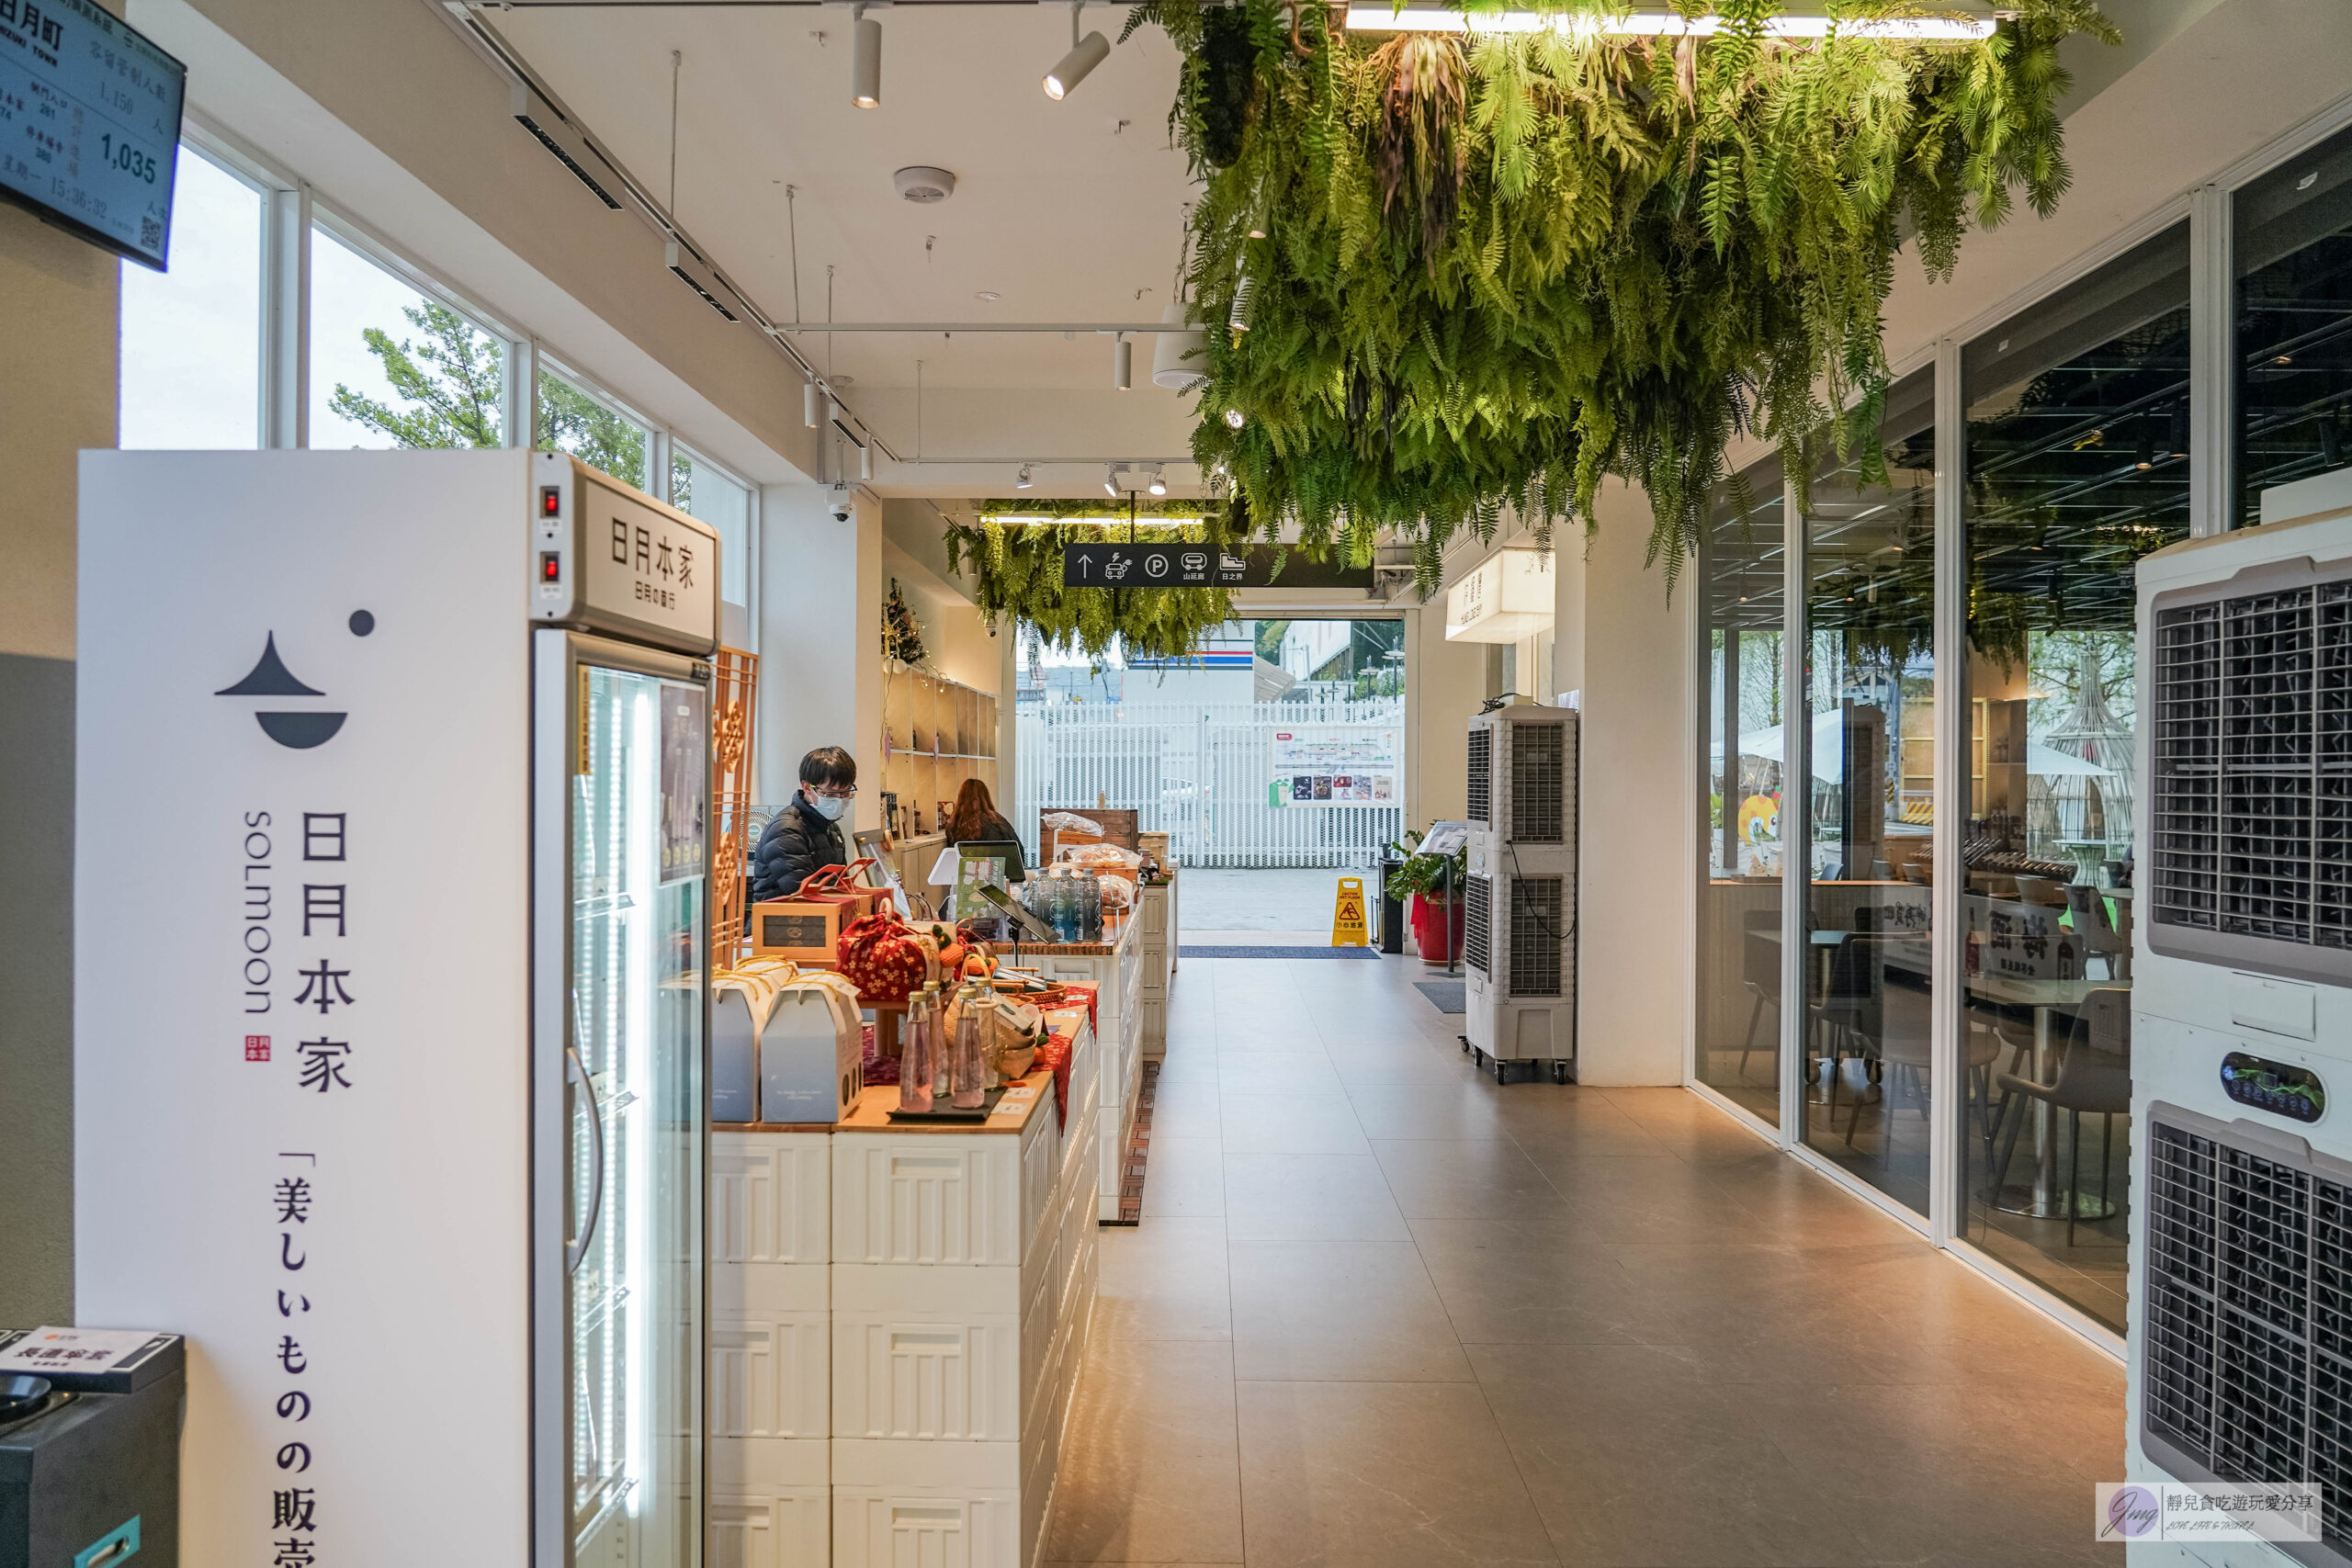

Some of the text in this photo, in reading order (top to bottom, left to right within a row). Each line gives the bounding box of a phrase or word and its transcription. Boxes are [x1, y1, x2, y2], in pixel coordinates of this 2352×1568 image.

[0, 0, 63, 51] 日月町
[101, 133, 156, 184] 1,035
[612, 517, 694, 590] 日月本家
[1222, 572, 1243, 581] 日之界
[293, 812, 356, 1093] 日月本家
